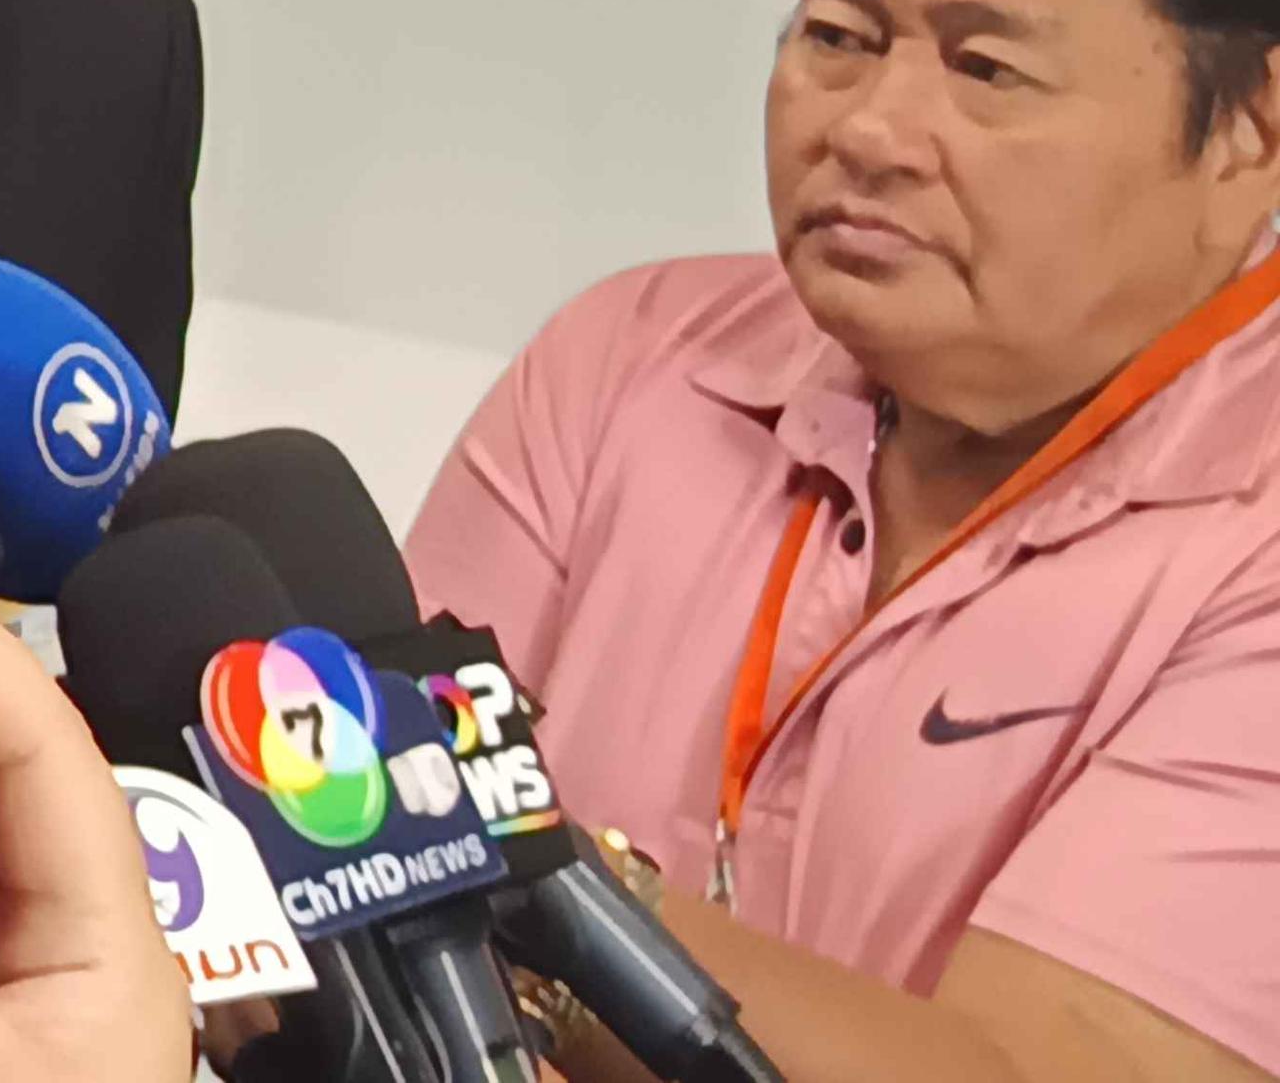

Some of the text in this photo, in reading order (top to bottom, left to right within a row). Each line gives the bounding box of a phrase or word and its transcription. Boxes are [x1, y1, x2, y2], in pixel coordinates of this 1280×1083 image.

[281, 702, 324, 763] 7
[416, 662, 514, 755] OP
[458, 745, 552, 821] WS
[406, 832, 489, 888] NEWS
